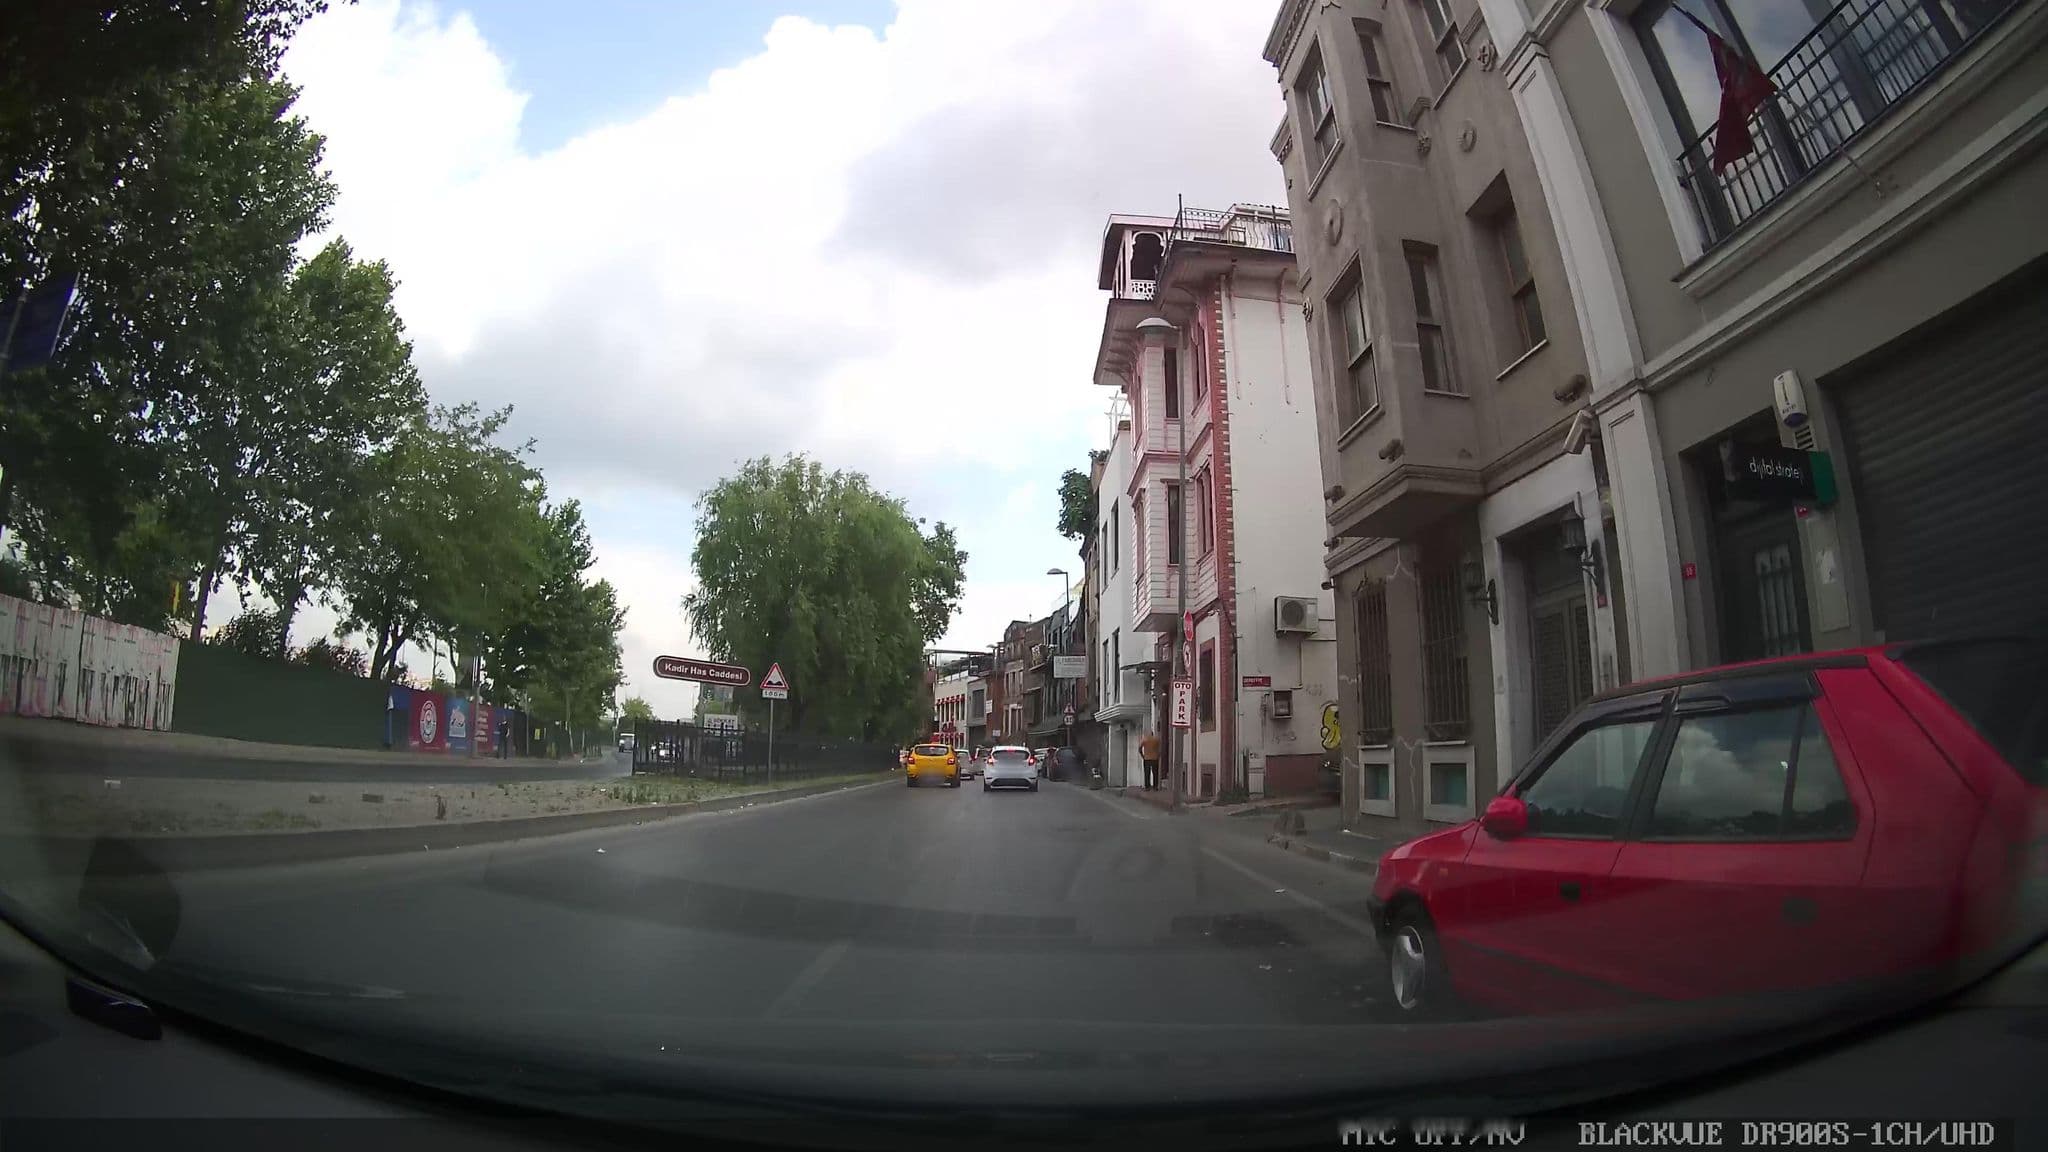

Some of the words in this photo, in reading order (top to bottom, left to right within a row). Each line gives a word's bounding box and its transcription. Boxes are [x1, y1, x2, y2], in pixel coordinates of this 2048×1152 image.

[664, 663, 688, 673] Kadir
[690, 666, 707, 676] Has
[709, 668, 743, 680] Caddesi
[1174, 682, 1191, 690] OTO
[1178, 690, 1186, 720] PARK
